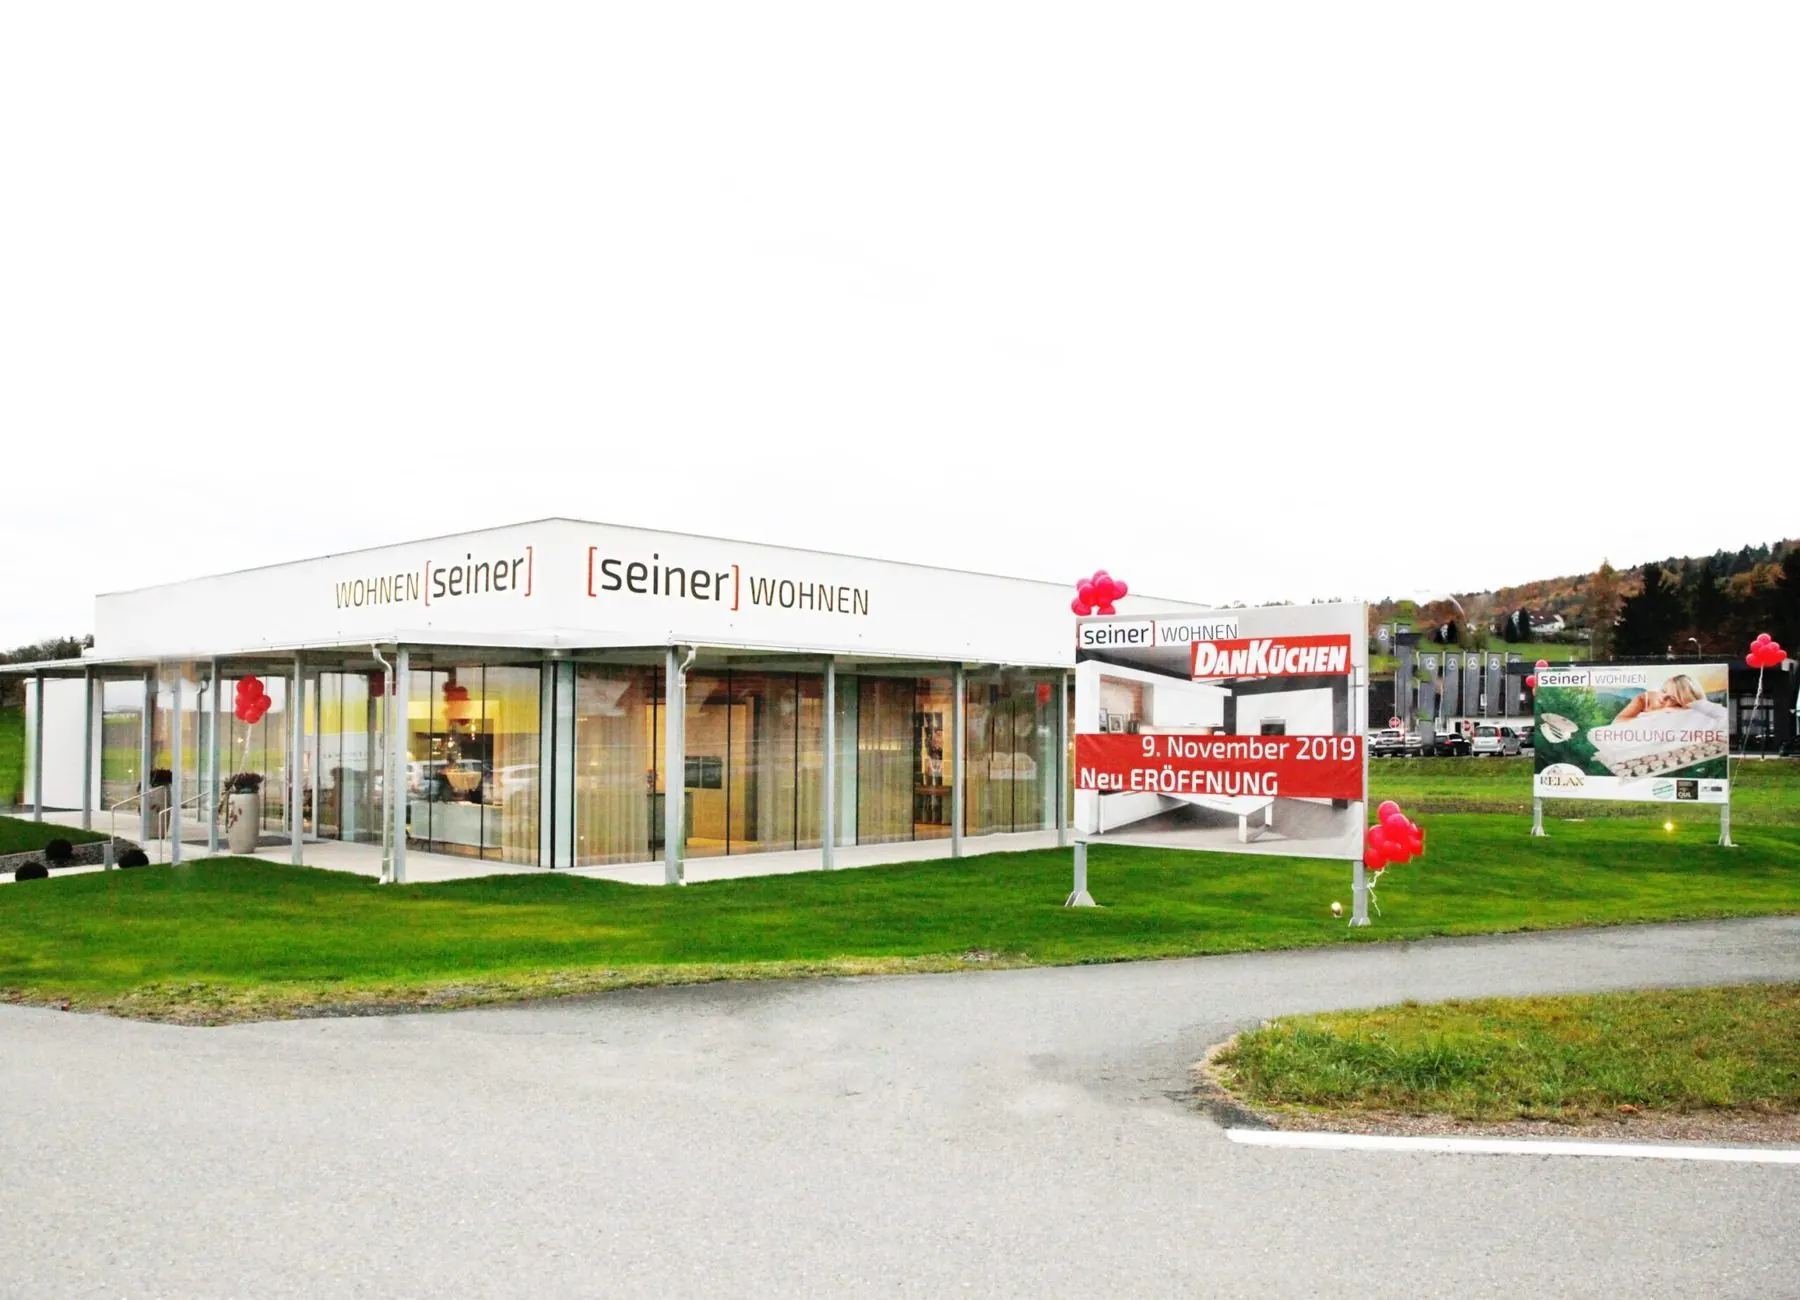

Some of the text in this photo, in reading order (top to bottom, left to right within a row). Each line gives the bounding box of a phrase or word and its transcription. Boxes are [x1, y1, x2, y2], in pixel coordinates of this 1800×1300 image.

[336, 571, 419, 610] WOHNEN
[750, 576, 869, 616] WOHNEN
[1161, 623, 1238, 642] WOHNEN
[1594, 674, 1647, 685] WOHNEN
[1594, 729, 1725, 743] ERHOLUNG ZIRBE
[1142, 735, 1356, 761] 9. November 2019
[1080, 764, 1279, 796] Neu ERÖFFNUNG
[1540, 776, 1584, 787] RELAX
